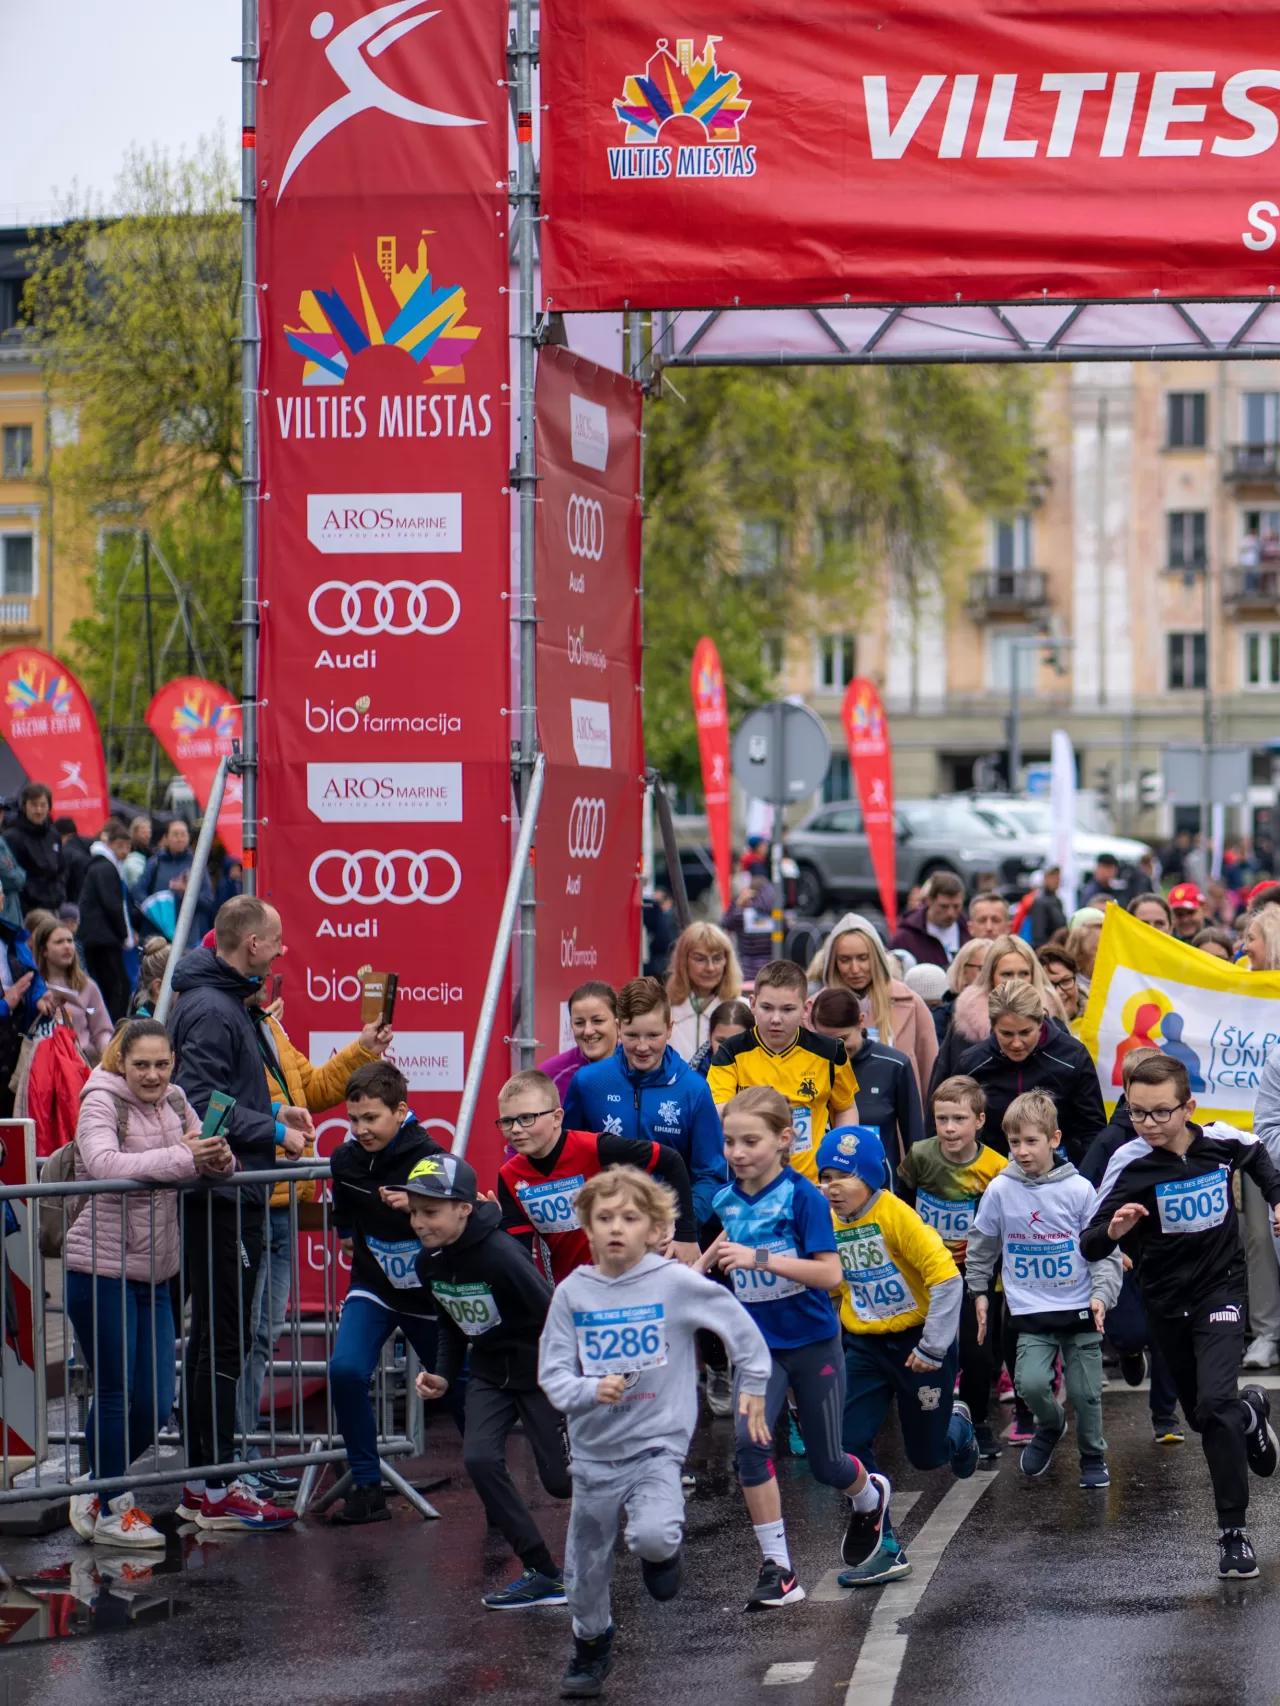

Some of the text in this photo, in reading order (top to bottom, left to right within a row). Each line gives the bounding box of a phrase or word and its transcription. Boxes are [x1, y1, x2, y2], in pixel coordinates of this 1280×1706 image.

[608, 145, 757, 179] VILTIES MIESTAS
[276, 394, 492, 439] VILTIES MIESTAS
[322, 508, 447, 530] AROS MARINE
[569, 572, 585, 593] Audi
[315, 650, 377, 669] Audi
[322, 777, 448, 799] AROS MARINE
[566, 875, 581, 895] Audi
[316, 919, 379, 938] Audi
[1220, 1025, 1255, 1049] ŠV.
[398, 1056, 449, 1068] MARINE
[654, 1126, 681, 1135] EIMANTAS
[1164, 1187, 1225, 1223] 5003
[919, 1203, 969, 1232] 5116
[838, 1240, 884, 1271] 6156
[1014, 1255, 1073, 1279] 5105
[852, 1280, 905, 1309] 5149
[1209, 1311, 1238, 1322] PUMA
[584, 1324, 660, 1361] 5286
